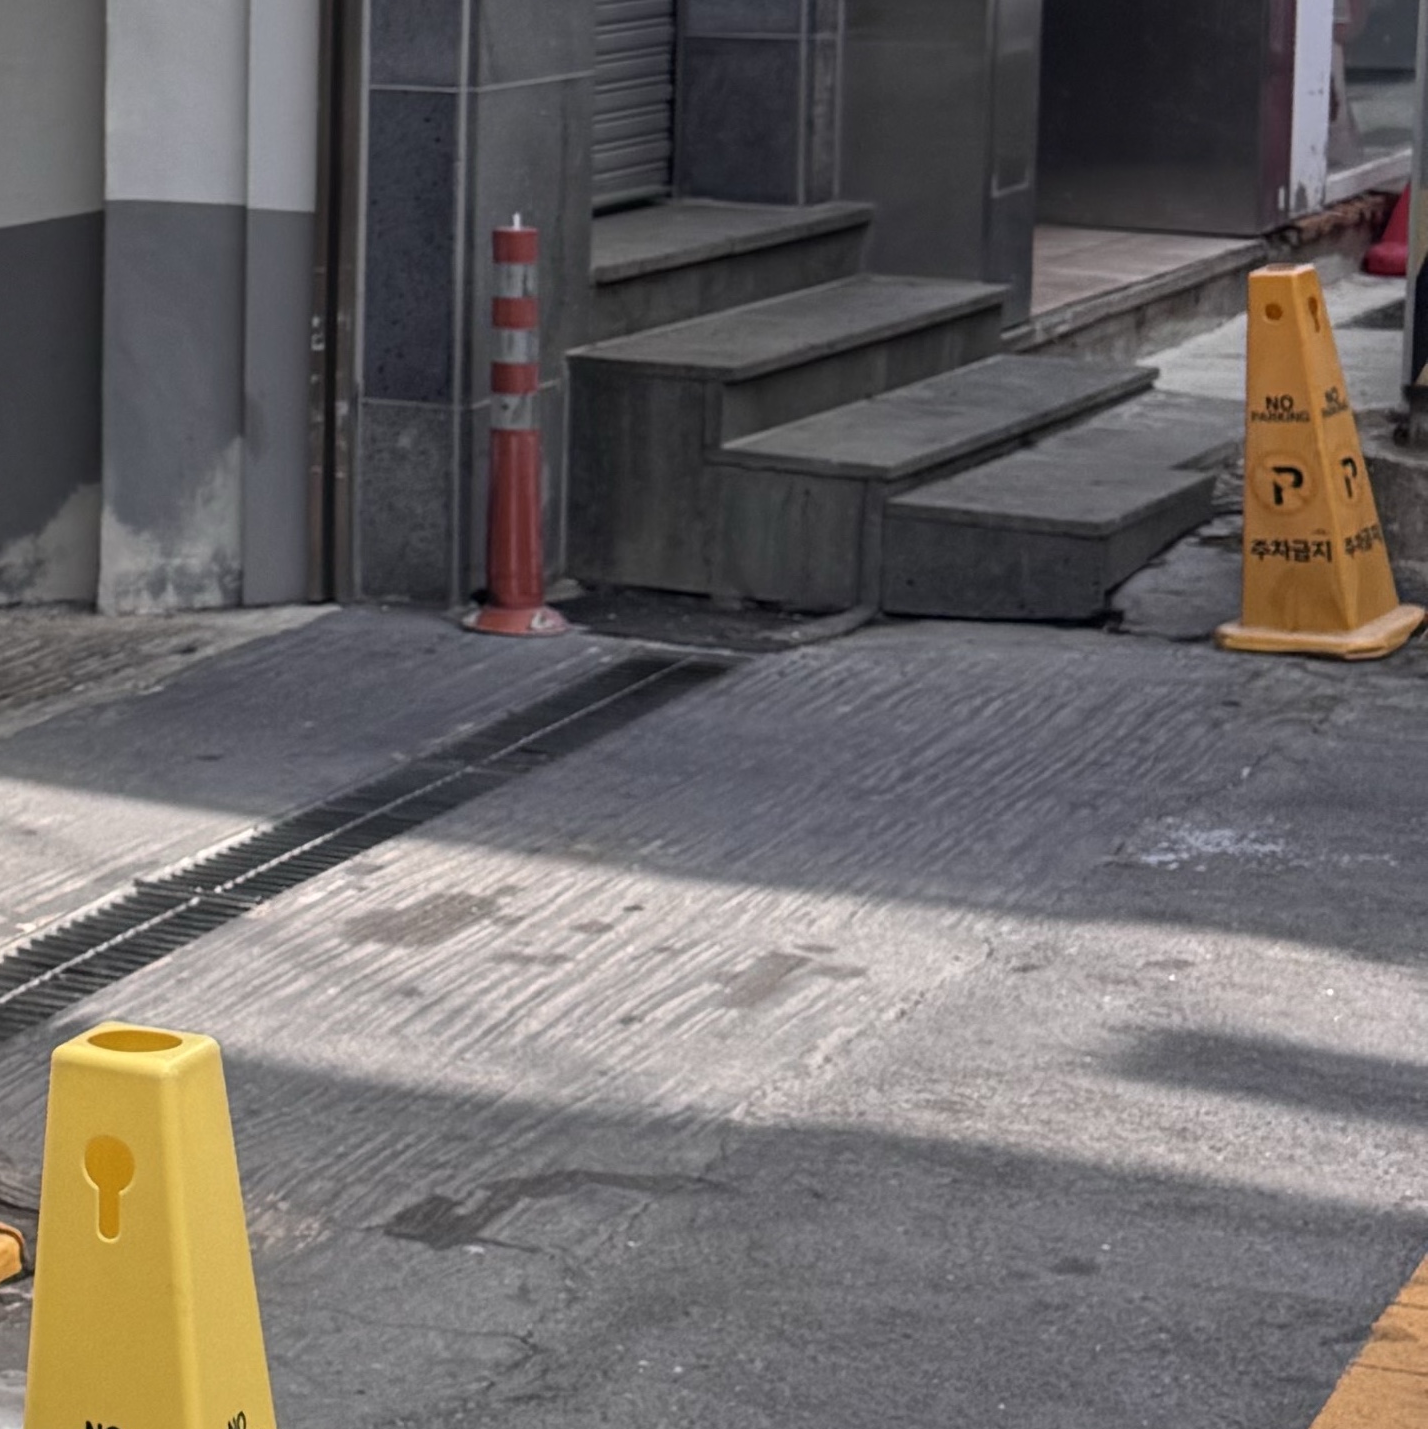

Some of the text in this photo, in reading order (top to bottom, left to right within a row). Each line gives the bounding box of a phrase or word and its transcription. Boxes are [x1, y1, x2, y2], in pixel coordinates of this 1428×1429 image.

[1265, 393, 1294, 412] NO
[1251, 410, 1311, 422] PARKING
[1250, 538, 1333, 564] 주차금지
